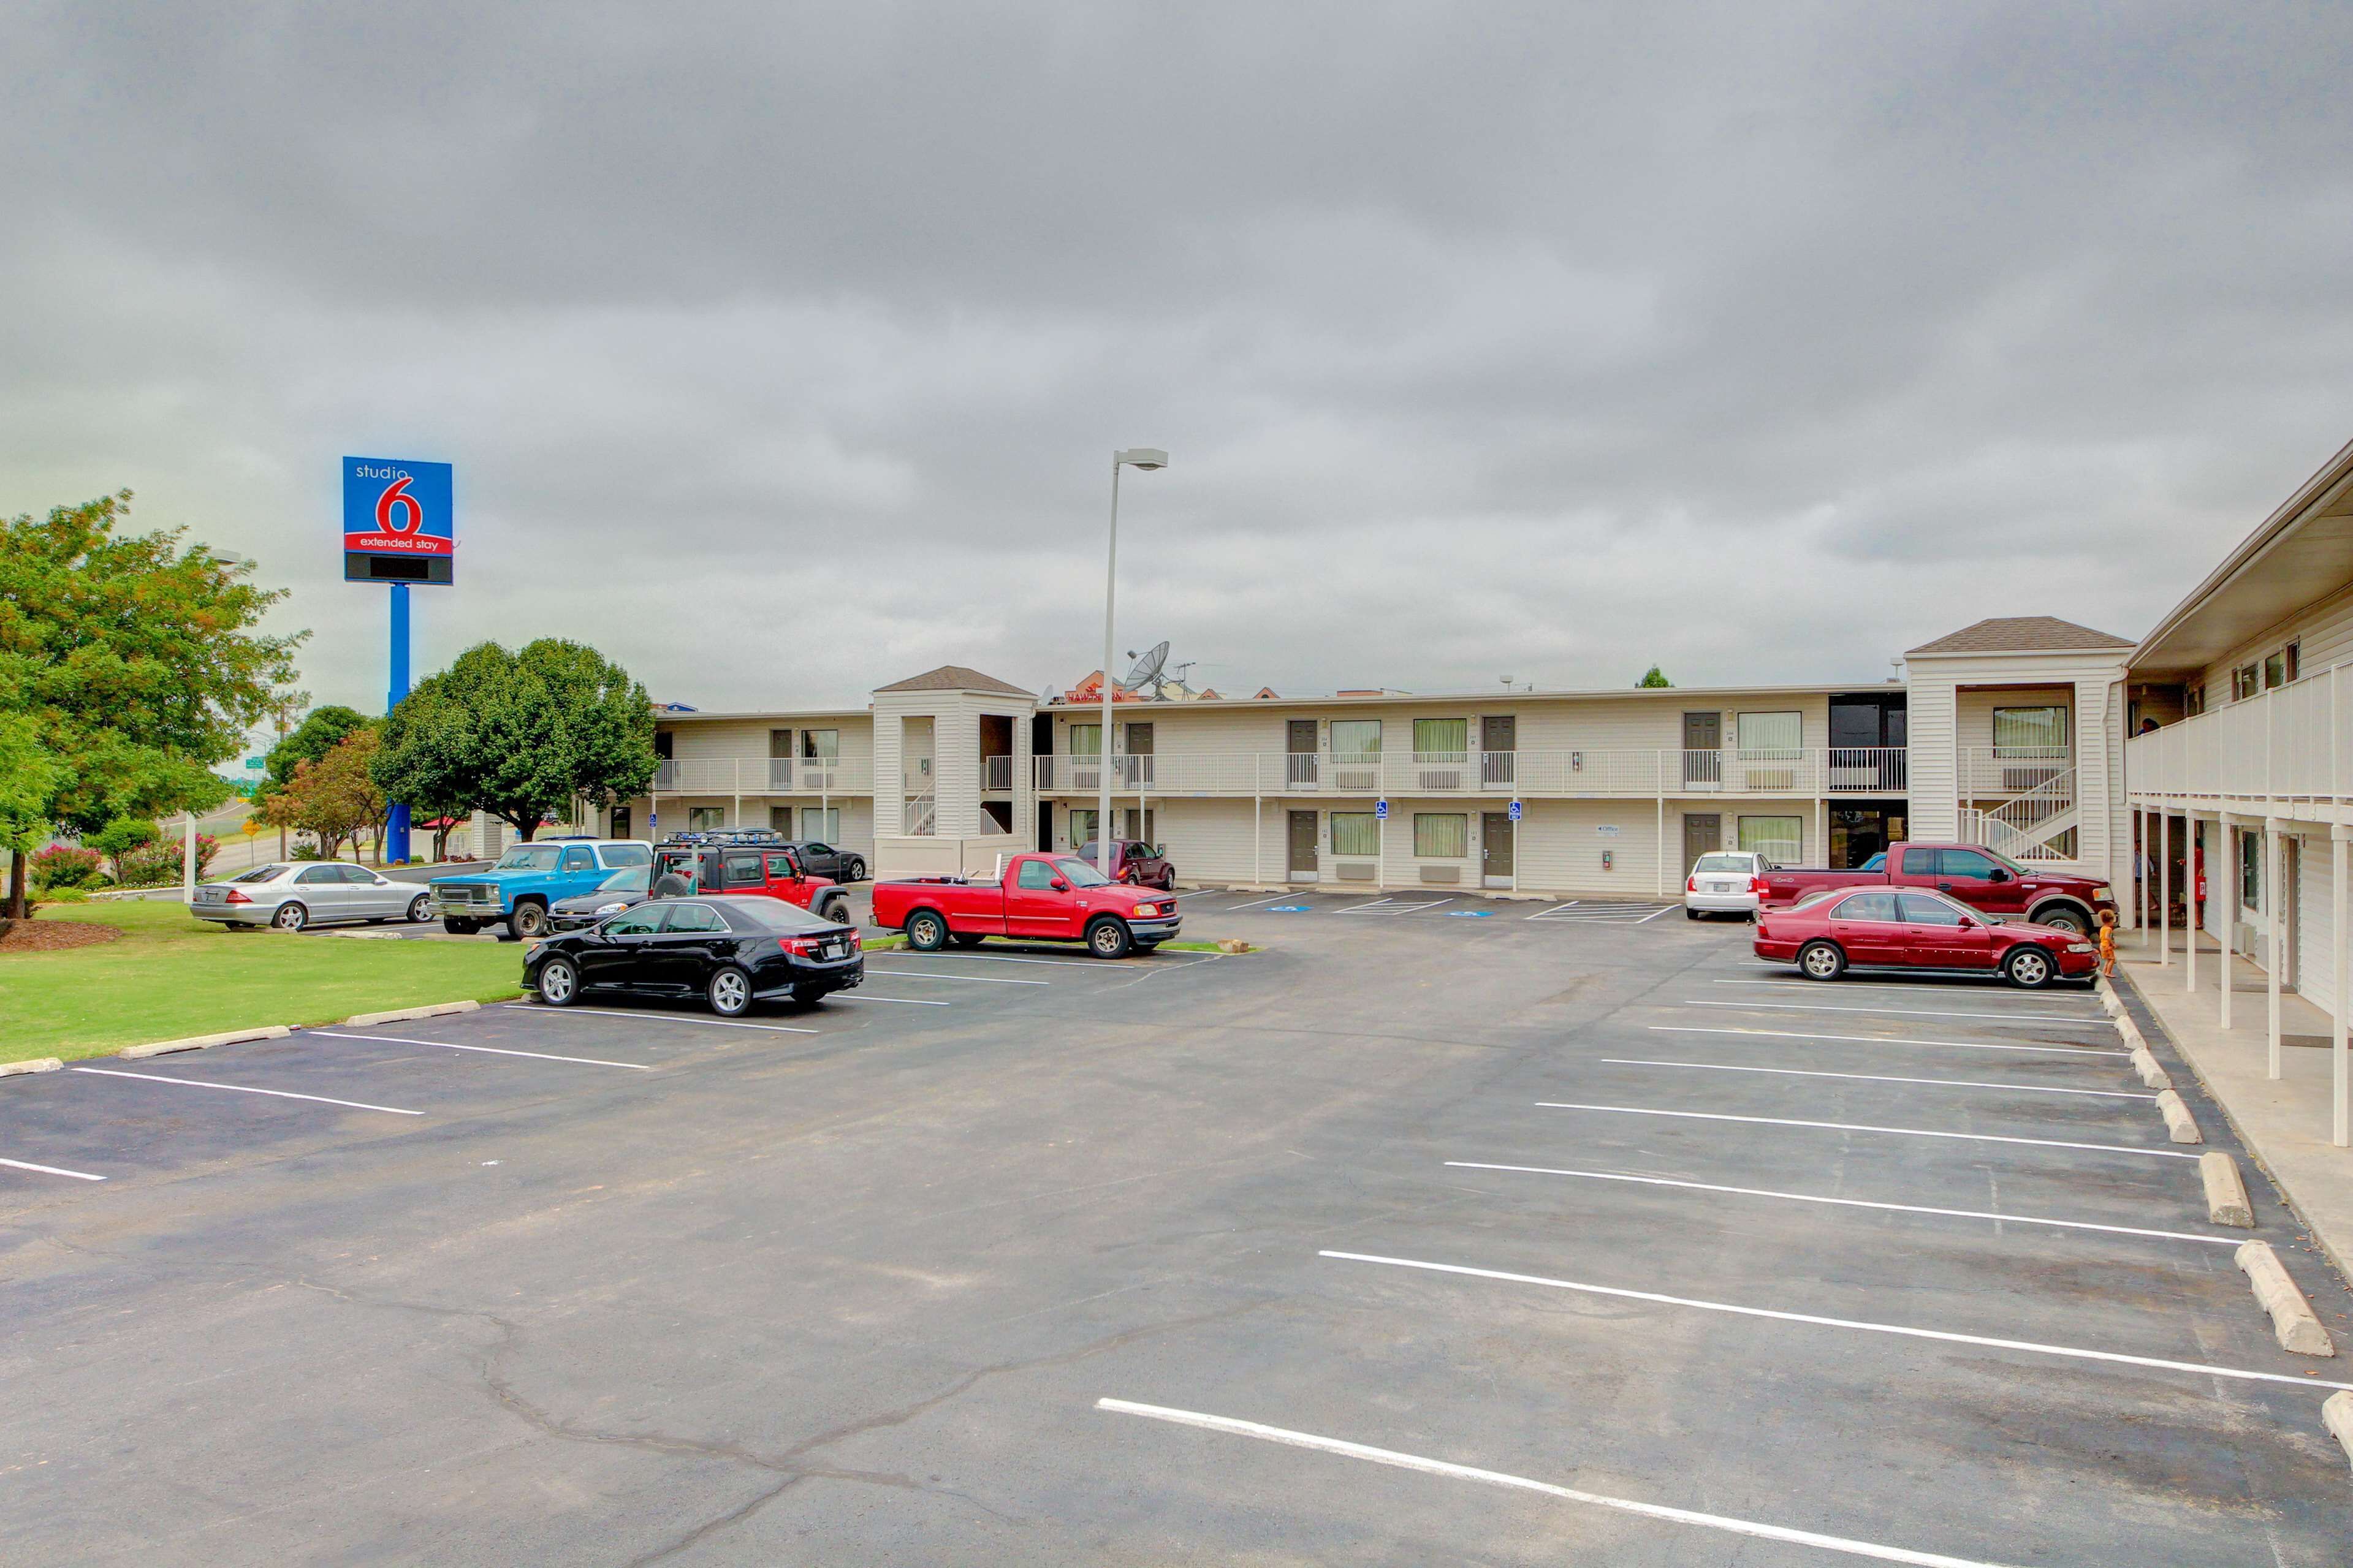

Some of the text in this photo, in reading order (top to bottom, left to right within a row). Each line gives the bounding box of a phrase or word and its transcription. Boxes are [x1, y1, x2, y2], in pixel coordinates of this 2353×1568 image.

[356, 465, 408, 480] studio
[375, 477, 423, 534] 6
[360, 537, 438, 551] extended stay
[1068, 692, 1123, 702] HAWTHRN
